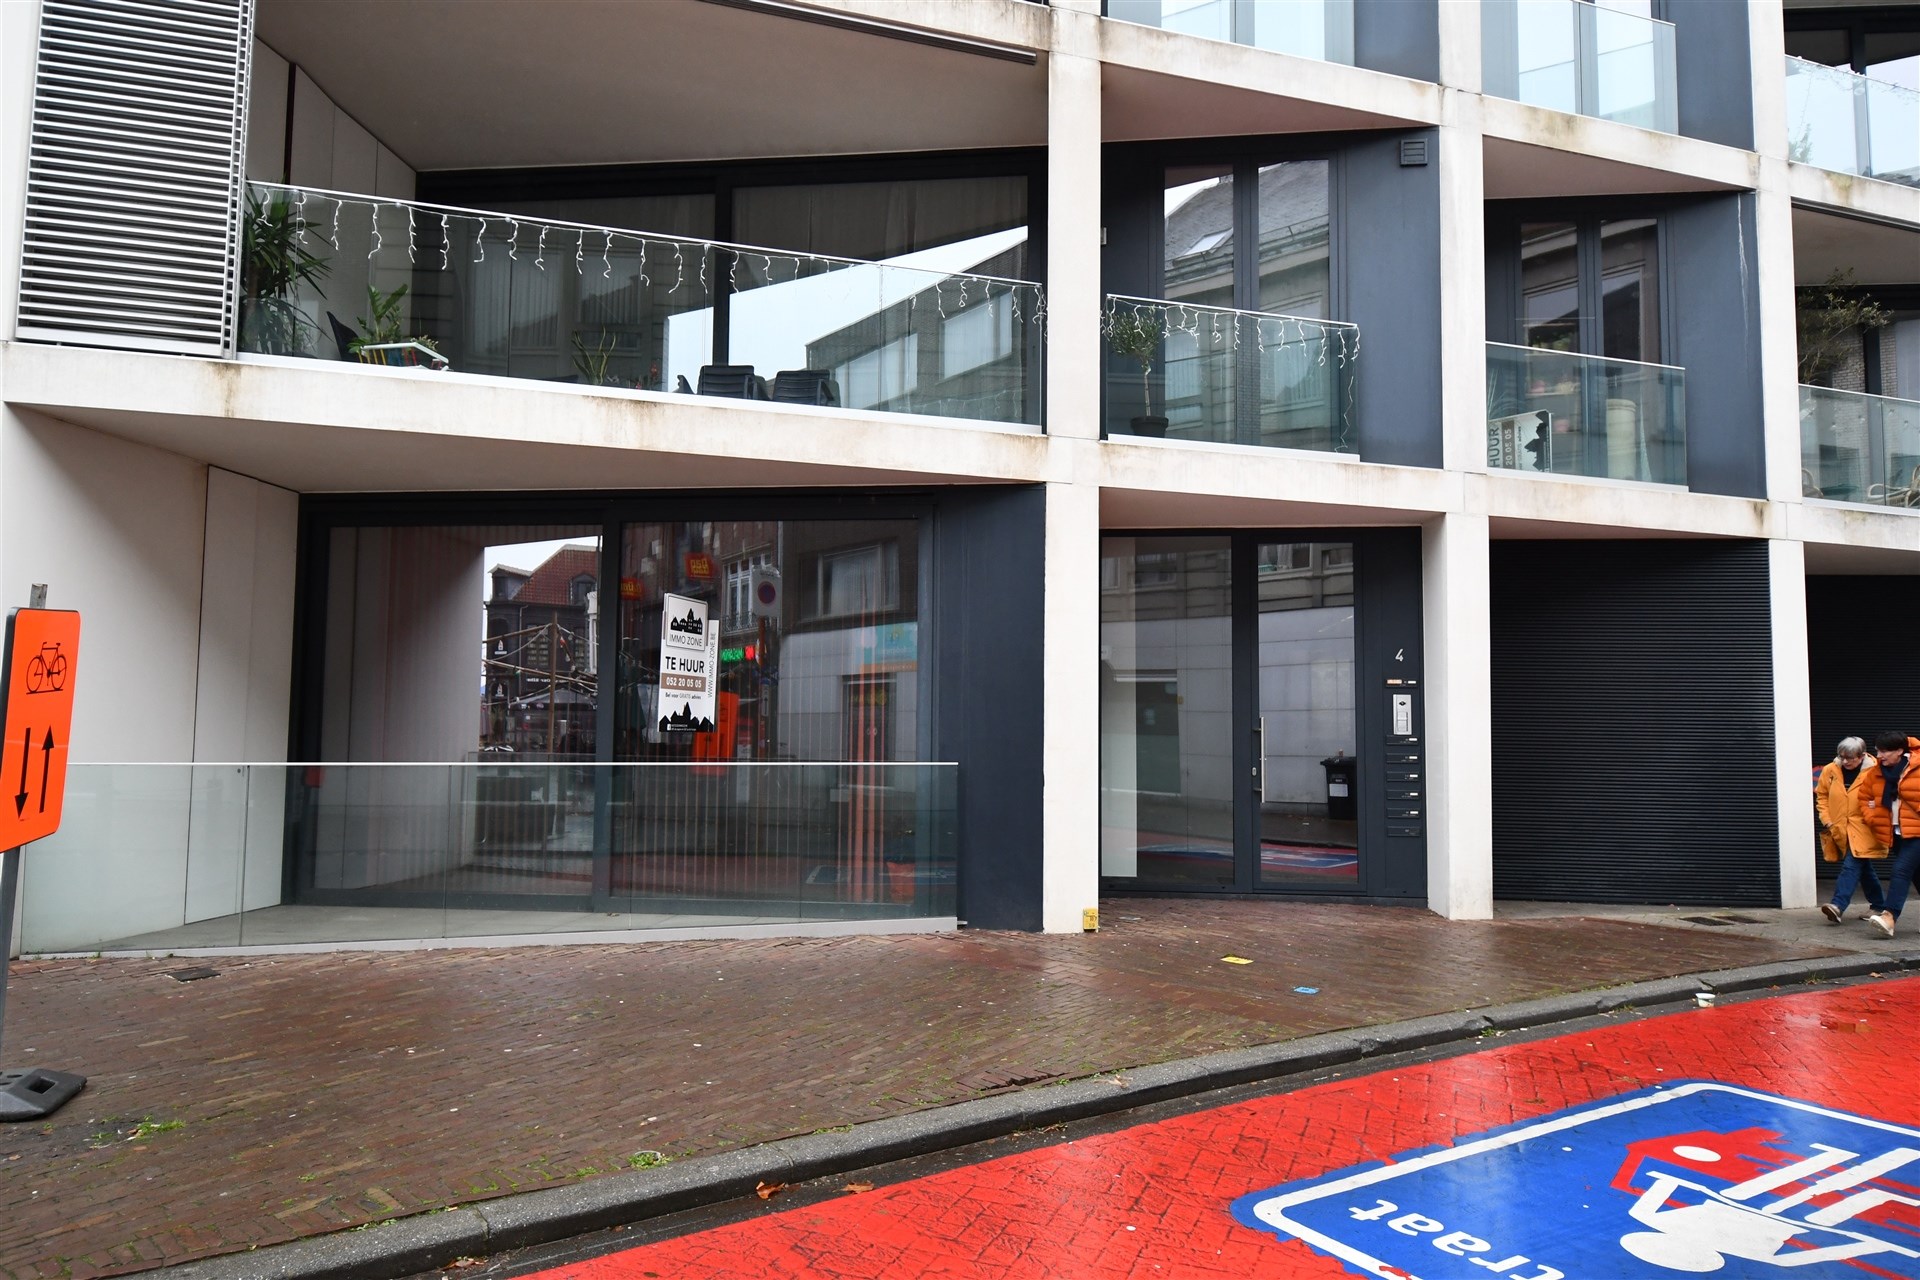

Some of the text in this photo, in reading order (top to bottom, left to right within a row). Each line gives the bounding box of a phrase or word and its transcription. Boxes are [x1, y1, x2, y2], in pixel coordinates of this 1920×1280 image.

[1504, 429, 1511, 440] 05
[1488, 427, 1500, 467] HUUR
[1505, 455, 1513, 466] 20
[669, 634, 702, 646] IMMO ZONE
[1395, 648, 1404, 662] 4
[665, 656, 704, 673] TE HUUR
[666, 676, 702, 689] 052 20 05 05
